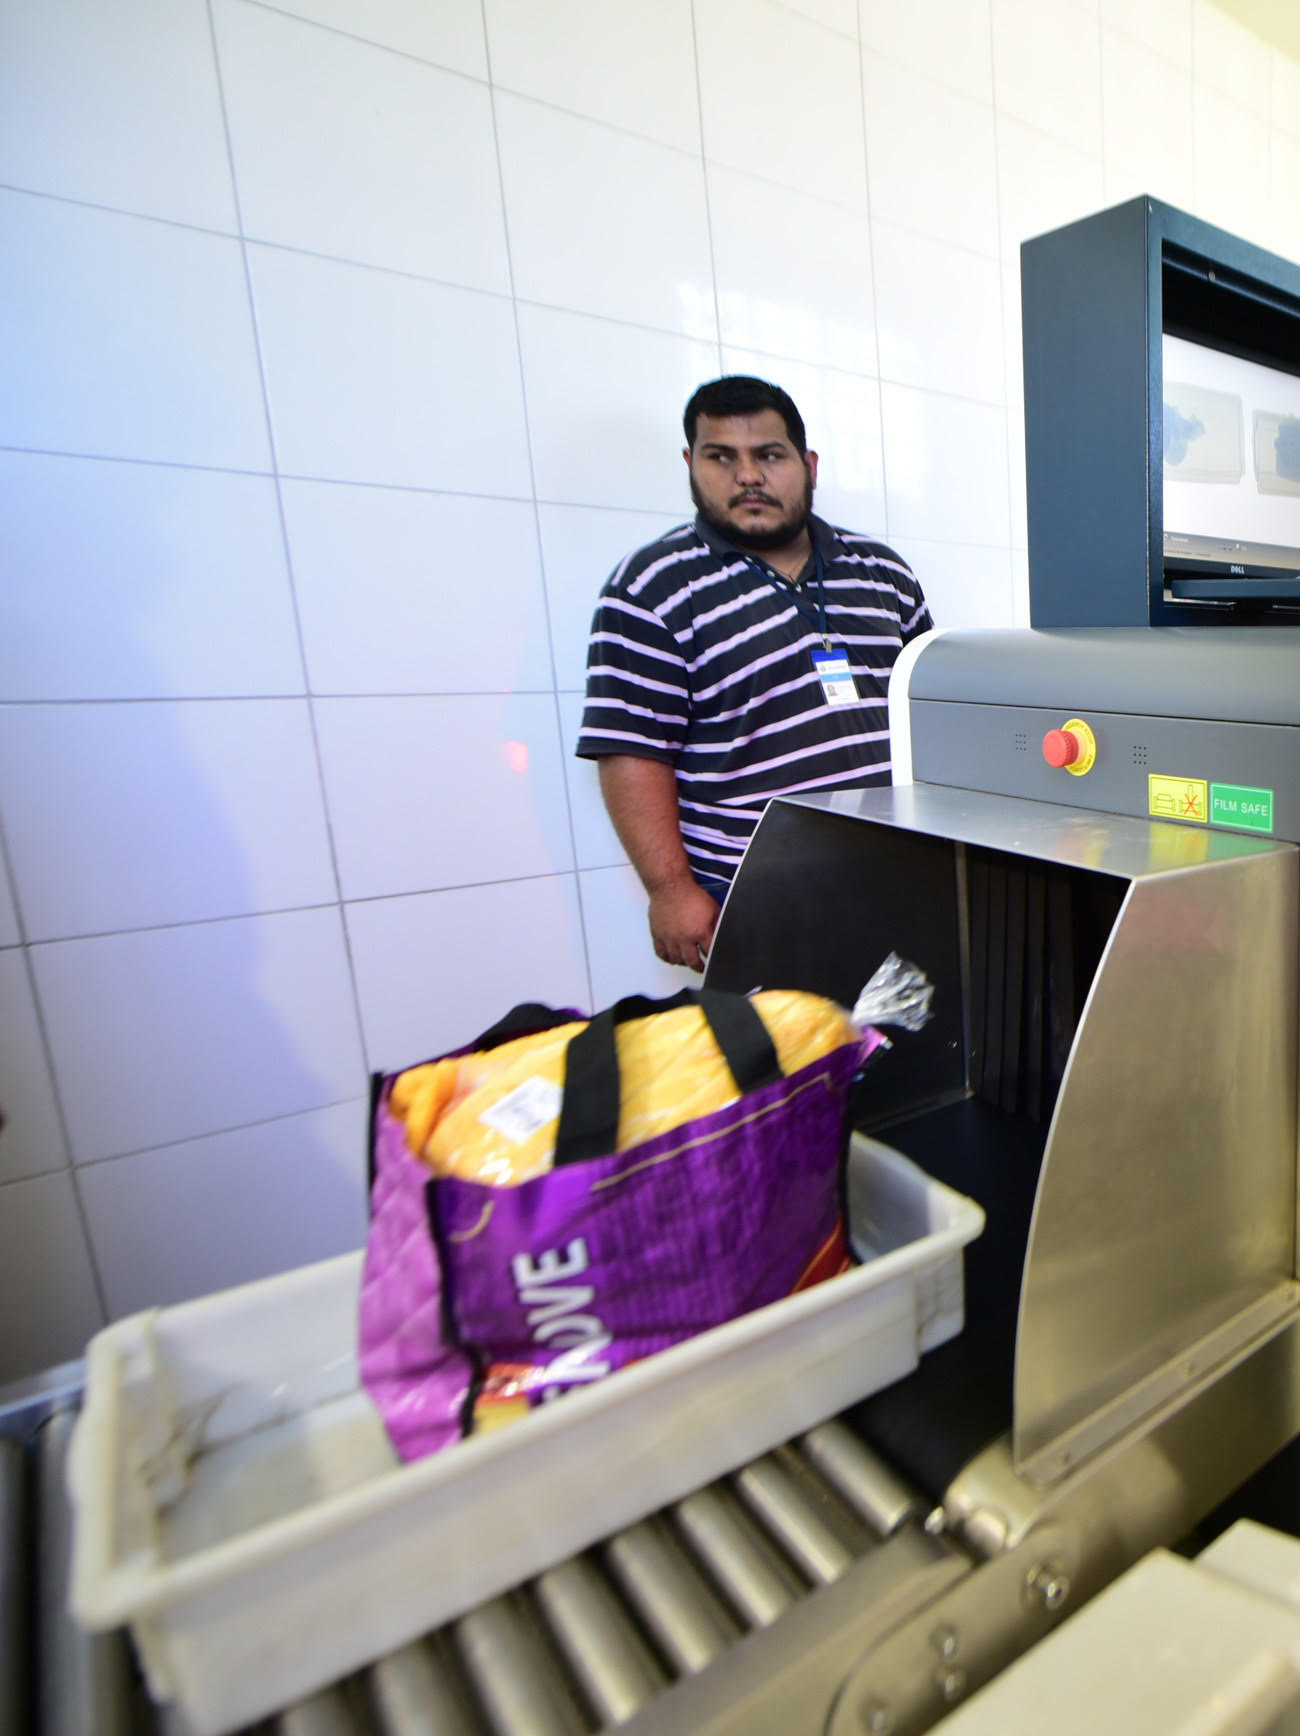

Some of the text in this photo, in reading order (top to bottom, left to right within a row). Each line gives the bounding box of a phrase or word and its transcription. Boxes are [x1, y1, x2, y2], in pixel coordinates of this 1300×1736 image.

[1230, 565, 1245, 575] DELL
[1213, 798, 1269, 817] FILM SAFE
